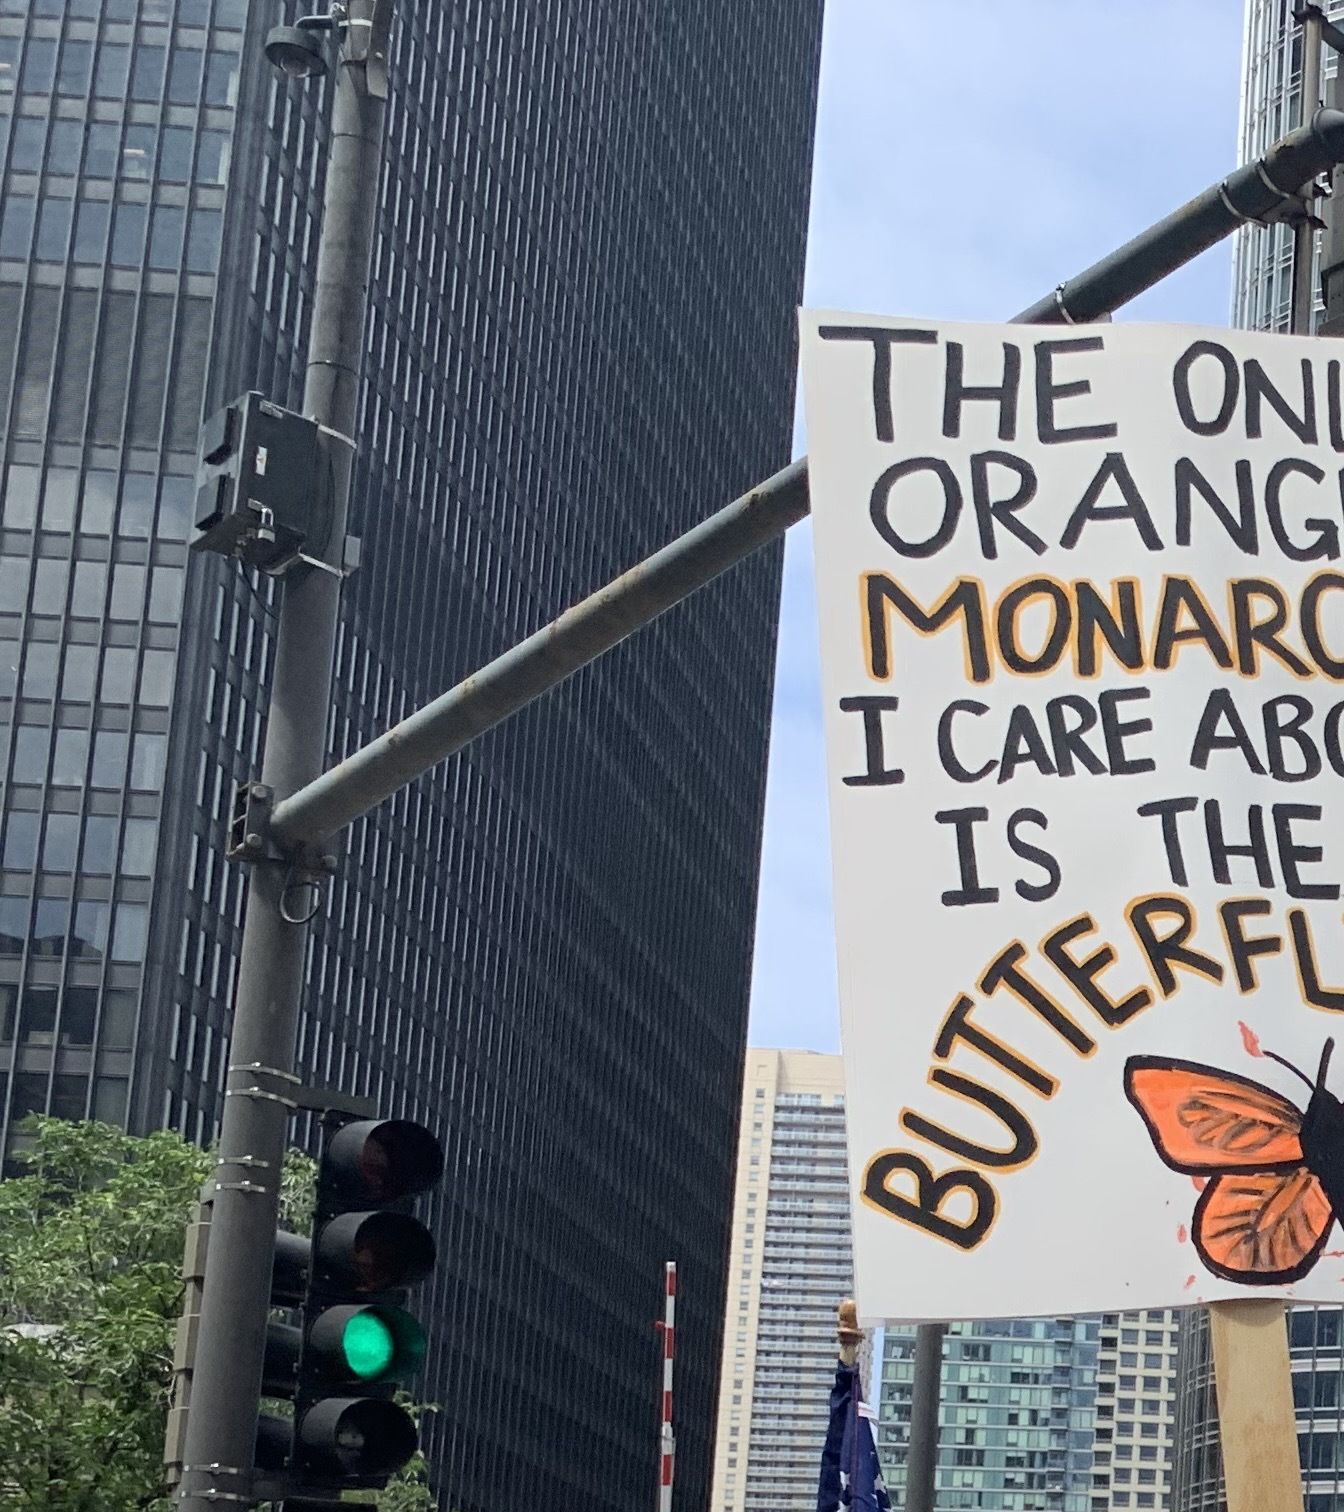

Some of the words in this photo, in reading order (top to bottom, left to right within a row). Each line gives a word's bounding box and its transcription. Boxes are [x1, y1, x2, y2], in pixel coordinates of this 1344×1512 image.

[818, 326, 1118, 445] THE
[839, 694, 905, 787] I
[937, 686, 1156, 785] CARE
[935, 805, 1062, 906] IS
[1137, 796, 1342, 901] THE
